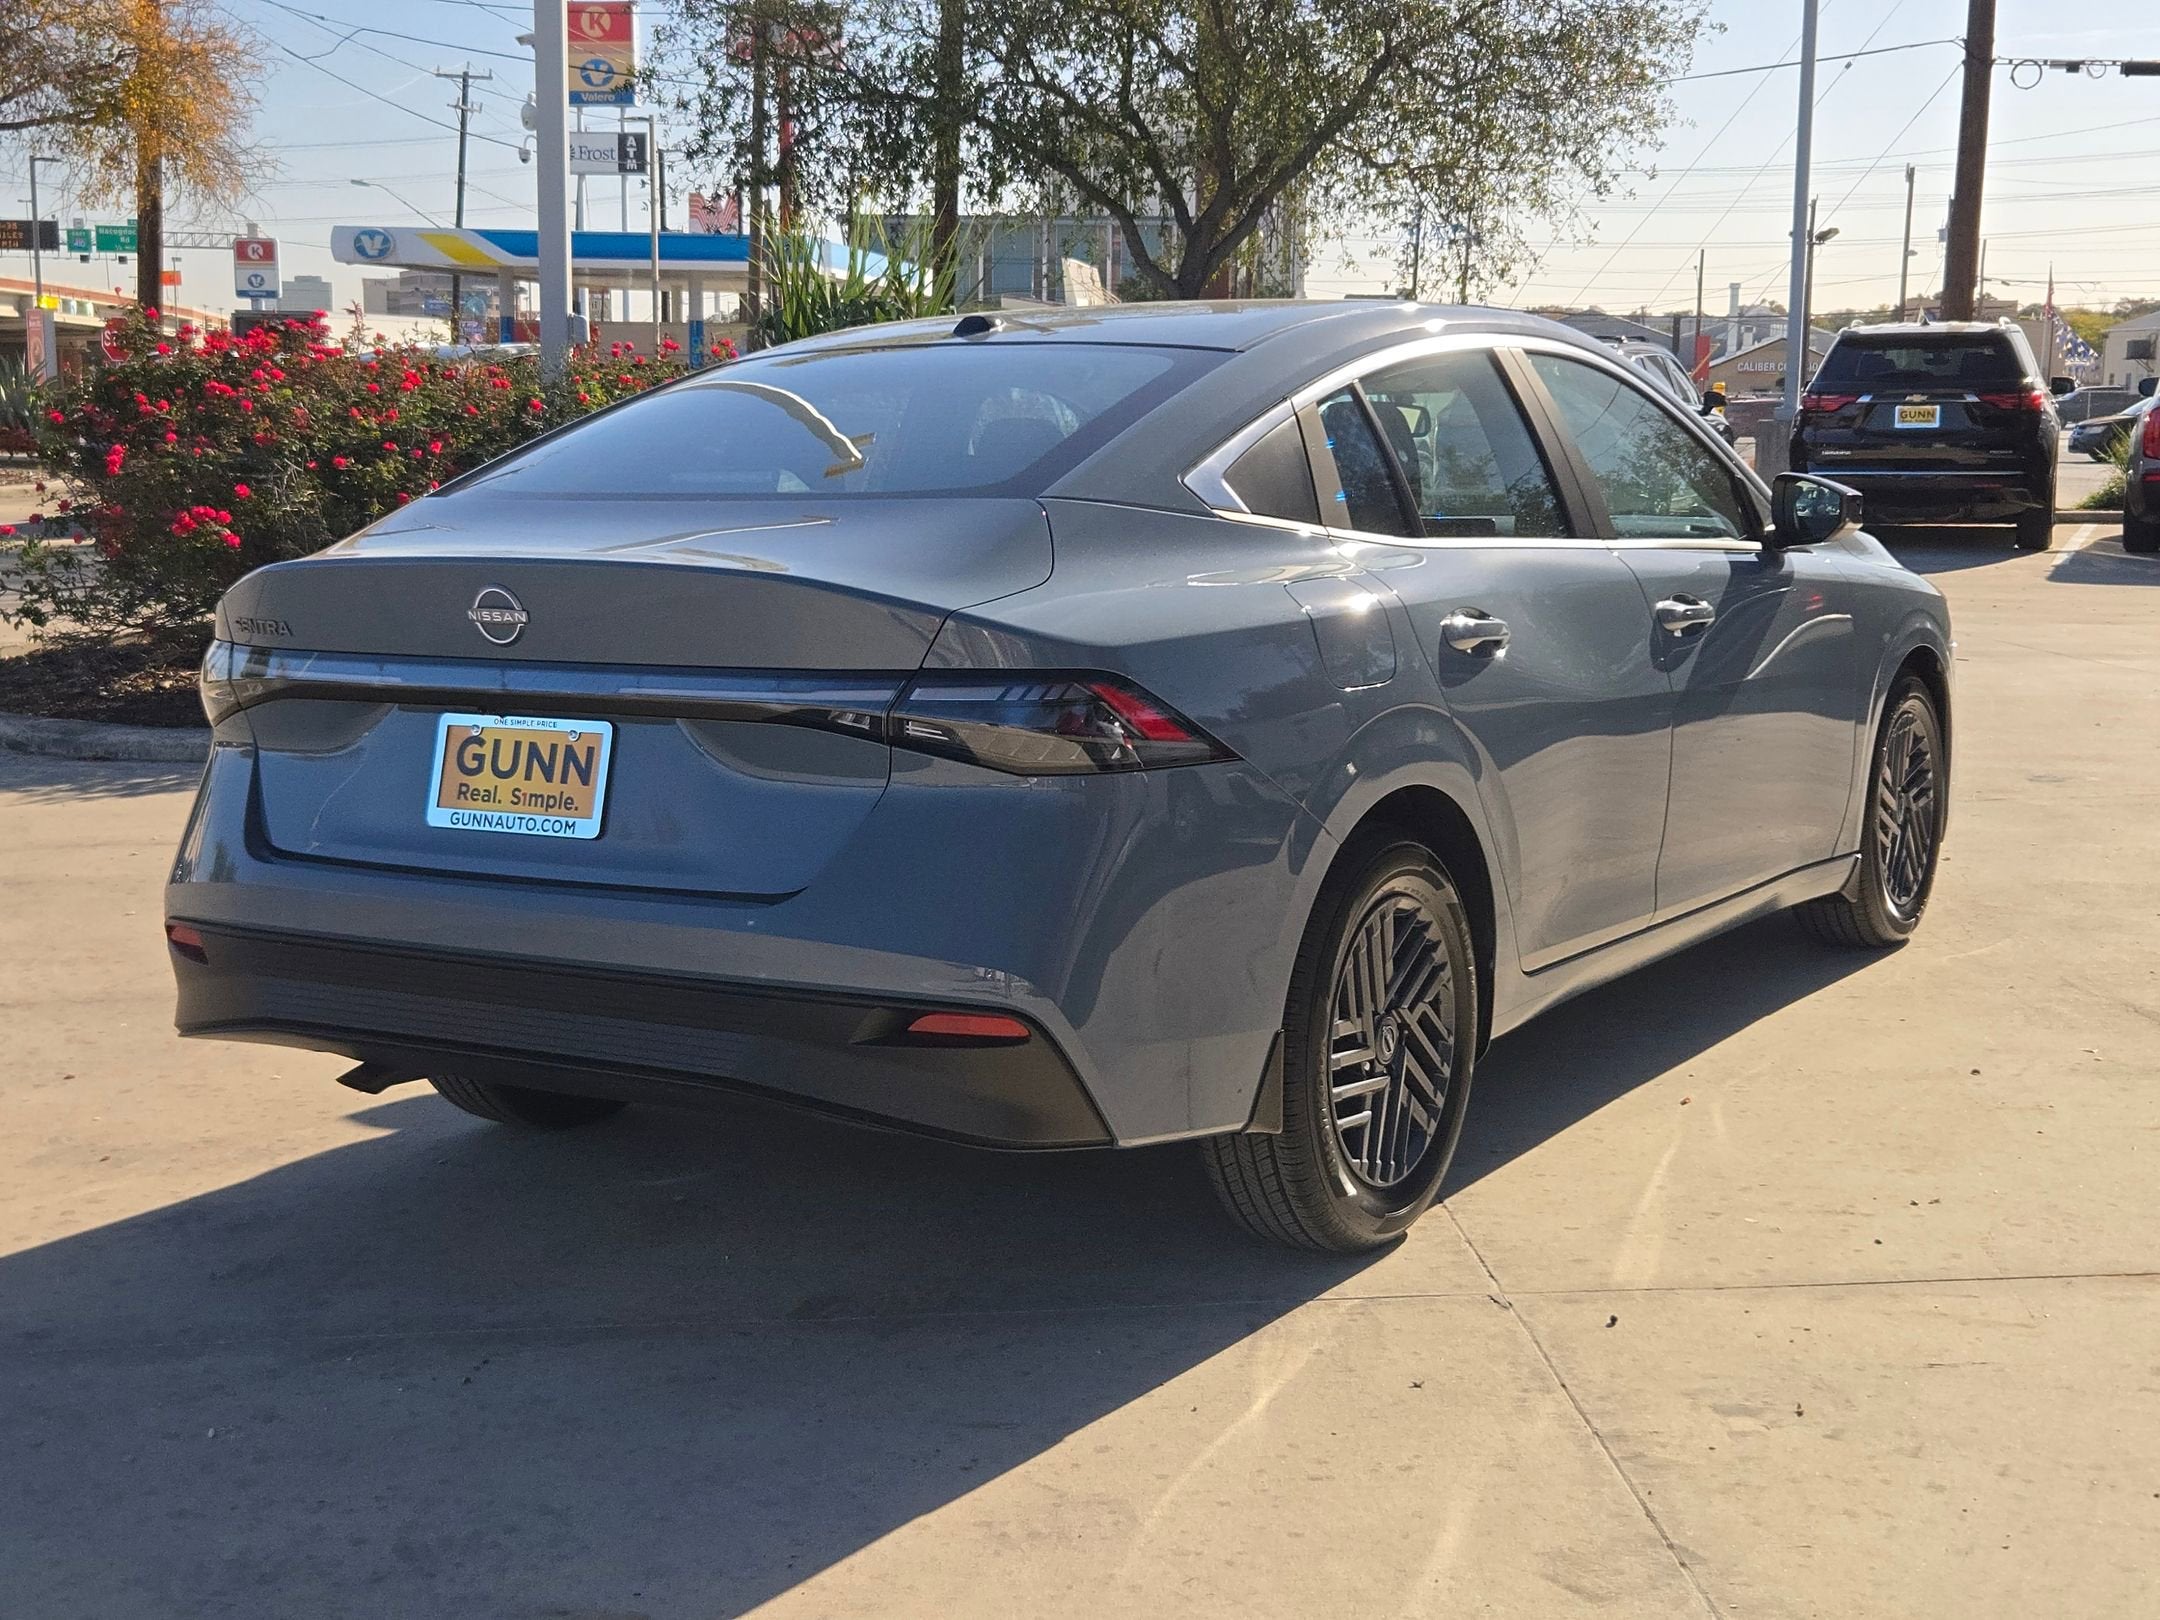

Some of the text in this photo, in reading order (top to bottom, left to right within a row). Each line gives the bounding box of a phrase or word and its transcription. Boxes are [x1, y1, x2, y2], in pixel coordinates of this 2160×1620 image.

[581, 92, 615, 102] Valero
[579, 146, 616, 161] Frost
[626, 137, 638, 170] ATM
[1737, 362, 1776, 373] CALIBER
[1900, 410, 1935, 420] GUNN
[468, 610, 526, 622] NISSAN
[493, 718, 558, 729] ONE SIMPLE PRICE
[456, 735, 595, 787] GUNN
[457, 783, 502, 805] Real.
[450, 811, 576, 835] GUNNAUTO.COM
